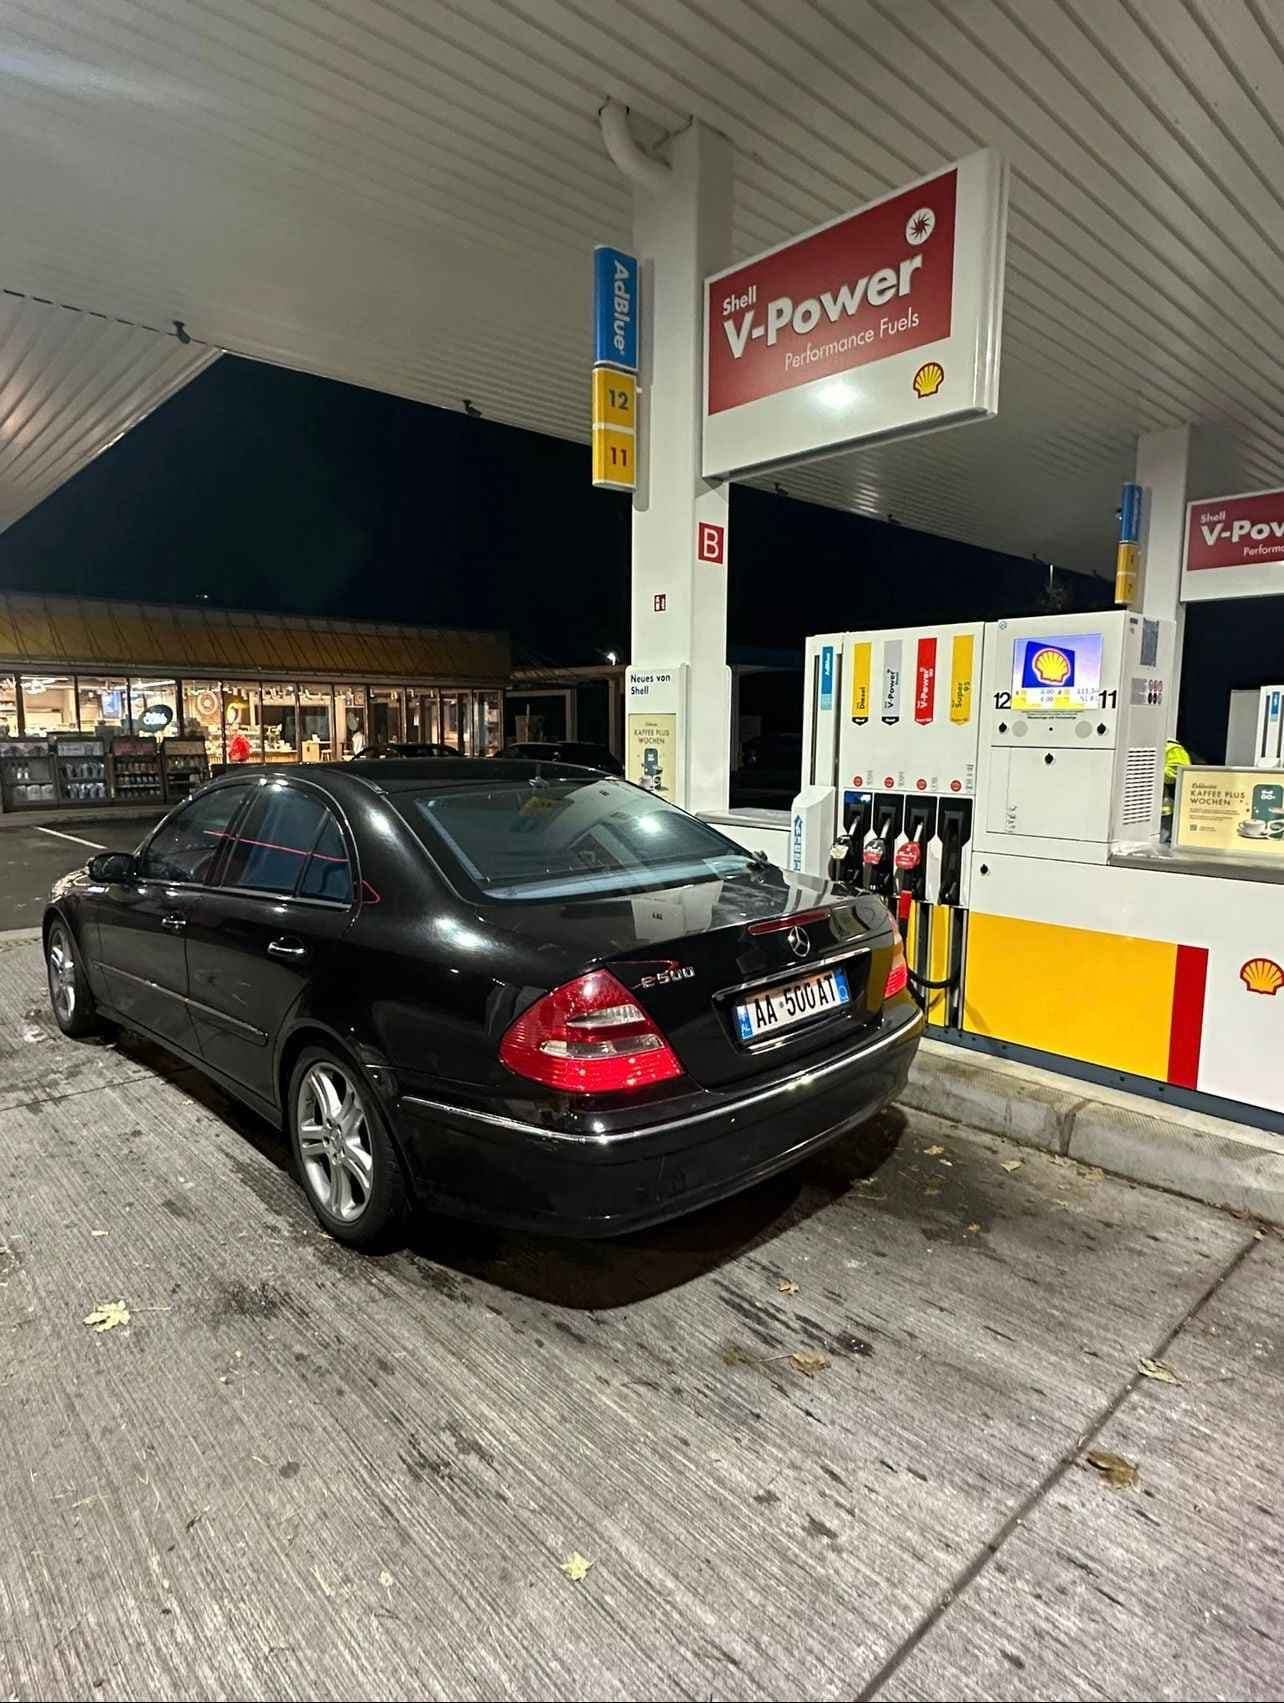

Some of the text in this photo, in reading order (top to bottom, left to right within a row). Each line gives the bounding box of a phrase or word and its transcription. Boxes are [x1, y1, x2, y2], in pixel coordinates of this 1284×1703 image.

[613, 259, 631, 351] AdBlue
[723, 285, 757, 316] Shell
[723, 253, 923, 360] V-Power
[784, 306, 920, 371] Performance Fuels
[608, 389, 629, 411] 12
[610, 447, 628, 467] 11
[1200, 510, 1226, 524] Shell
[703, 527, 720, 559] B
[630, 674, 671, 683] Neues von
[630, 686, 649, 695] Shell
[887, 669, 896, 709] V-Power
[920, 668, 929, 709] V-Power
[955, 682, 963, 708] Super
[993, 691, 1012, 710] 12
[1099, 690, 1118, 709] 11
[1190, 790, 1246, 800] KAFFEE PLUS
[1190, 798, 1231, 807] WOCHEN
[754, 974, 837, 1028] AA 500 AT
